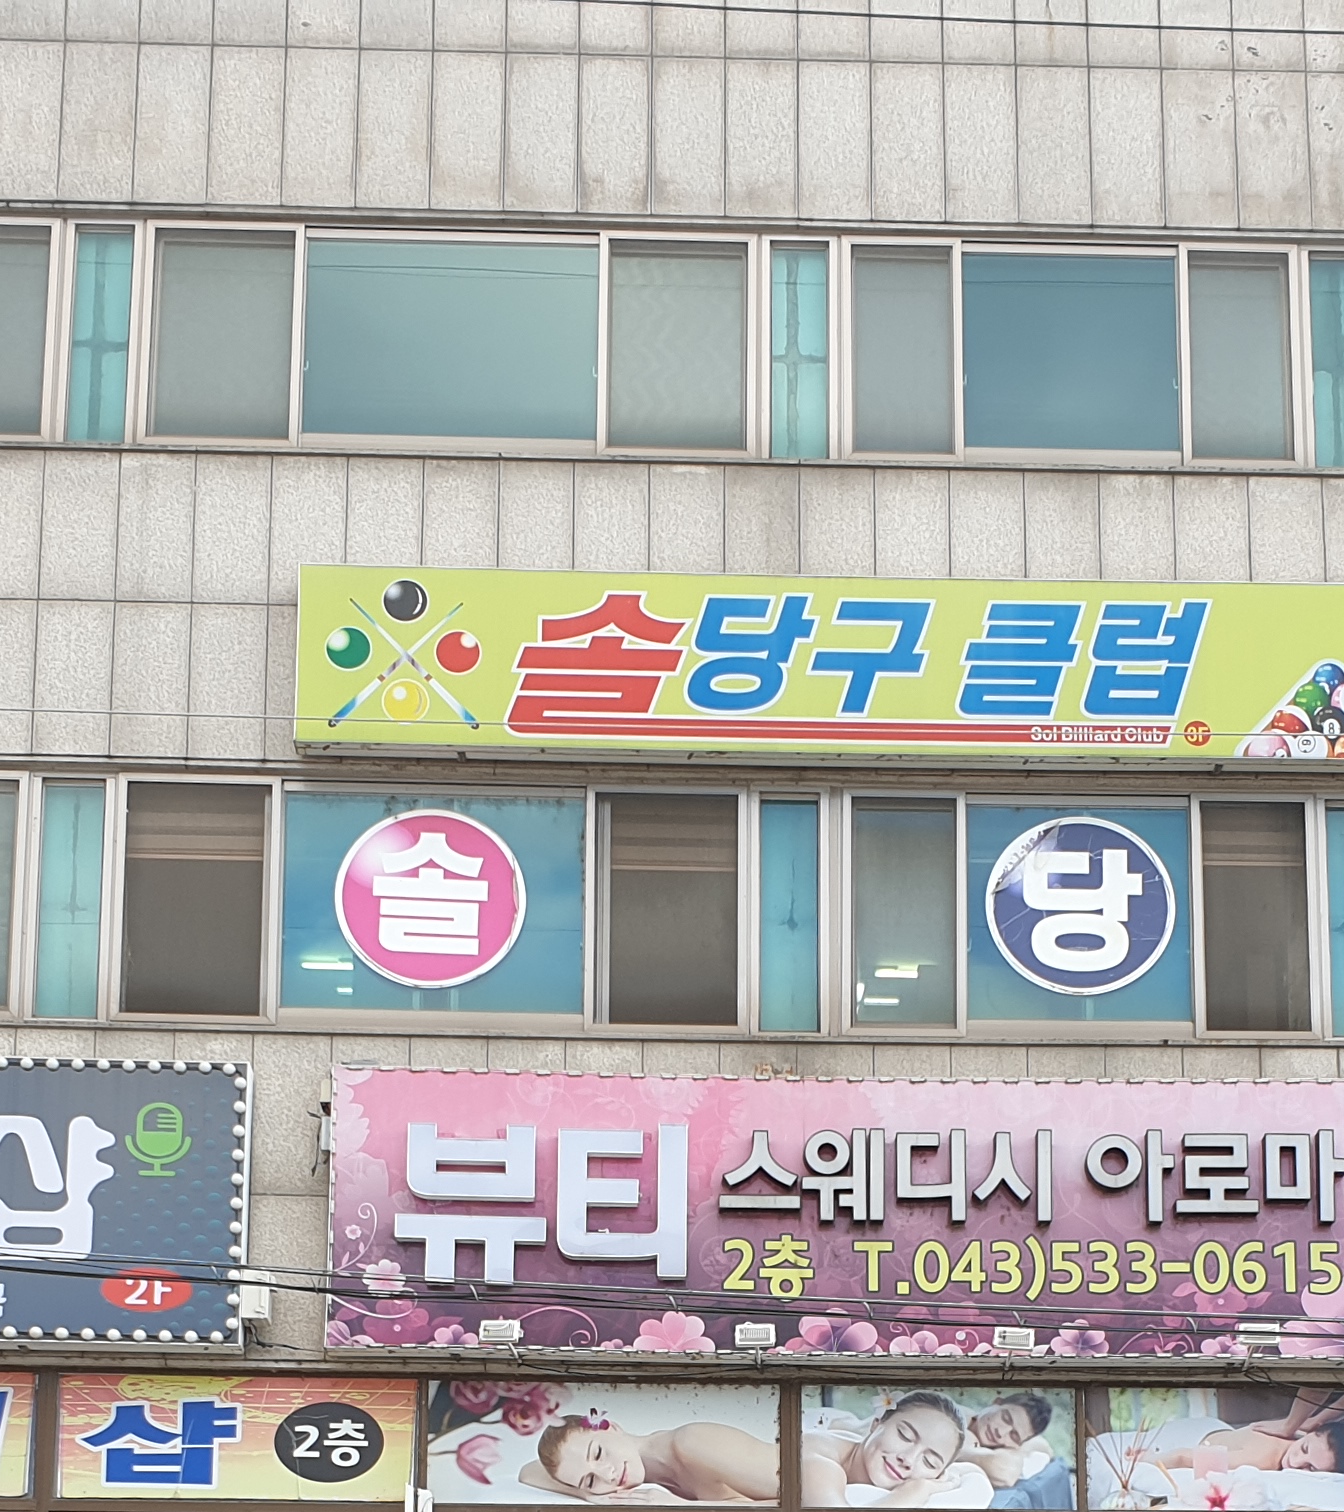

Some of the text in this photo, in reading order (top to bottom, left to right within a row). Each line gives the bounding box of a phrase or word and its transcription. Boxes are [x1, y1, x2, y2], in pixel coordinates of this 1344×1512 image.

[957, 597, 1213, 721] 클럽
[1031, 725, 1208, 742] Sol Billiard Club 3F
[372, 831, 491, 956] 솔
[1024, 848, 1142, 972] 당
[395, 1121, 688, 1284] 뷰티
[718, 1128, 1054, 1222] 스웨디시
[723, 1236, 1344, 1300] 2층 T.043)533-0615
[292, 1418, 369, 1468] 2층
